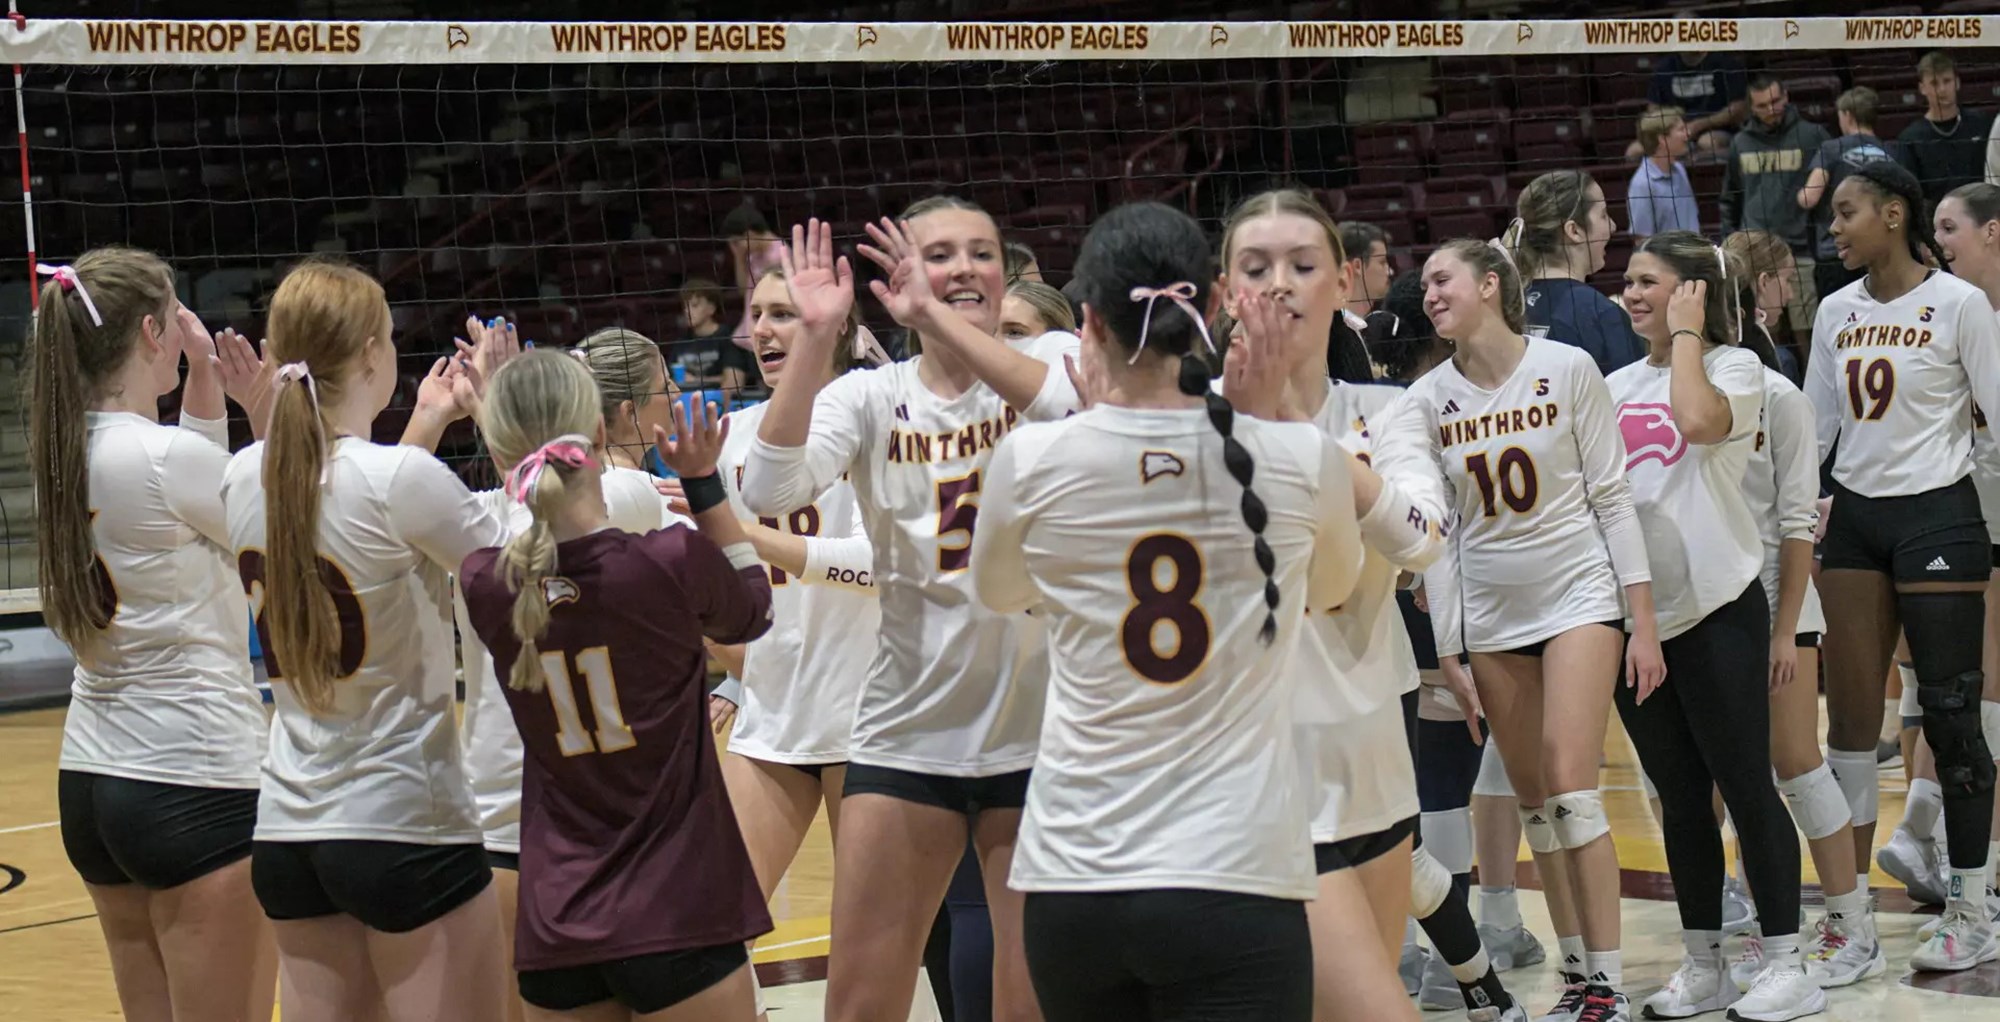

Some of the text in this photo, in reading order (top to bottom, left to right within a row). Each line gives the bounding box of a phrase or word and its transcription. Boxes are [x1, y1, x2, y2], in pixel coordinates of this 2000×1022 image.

[86, 23, 361, 52] WINTHROP EAGLES
[551, 25, 787, 51] WINTHROP EAGLES
[947, 25, 1149, 49] WINTHROP EAGLES
[1289, 24, 1464, 47] WINTHROP EAGLES
[1584, 21, 1739, 44] WINTHROP EAGLES
[1845, 18, 1982, 40] WINTHROP EAGLES
[1845, 355, 1896, 422] 19
[1439, 403, 1559, 448] WINTHROP
[1464, 446, 1539, 518] 10
[934, 468, 981, 574] 5
[825, 566, 874, 588] ROC
[1120, 532, 1212, 686] 8
[540, 645, 638, 757] 11
